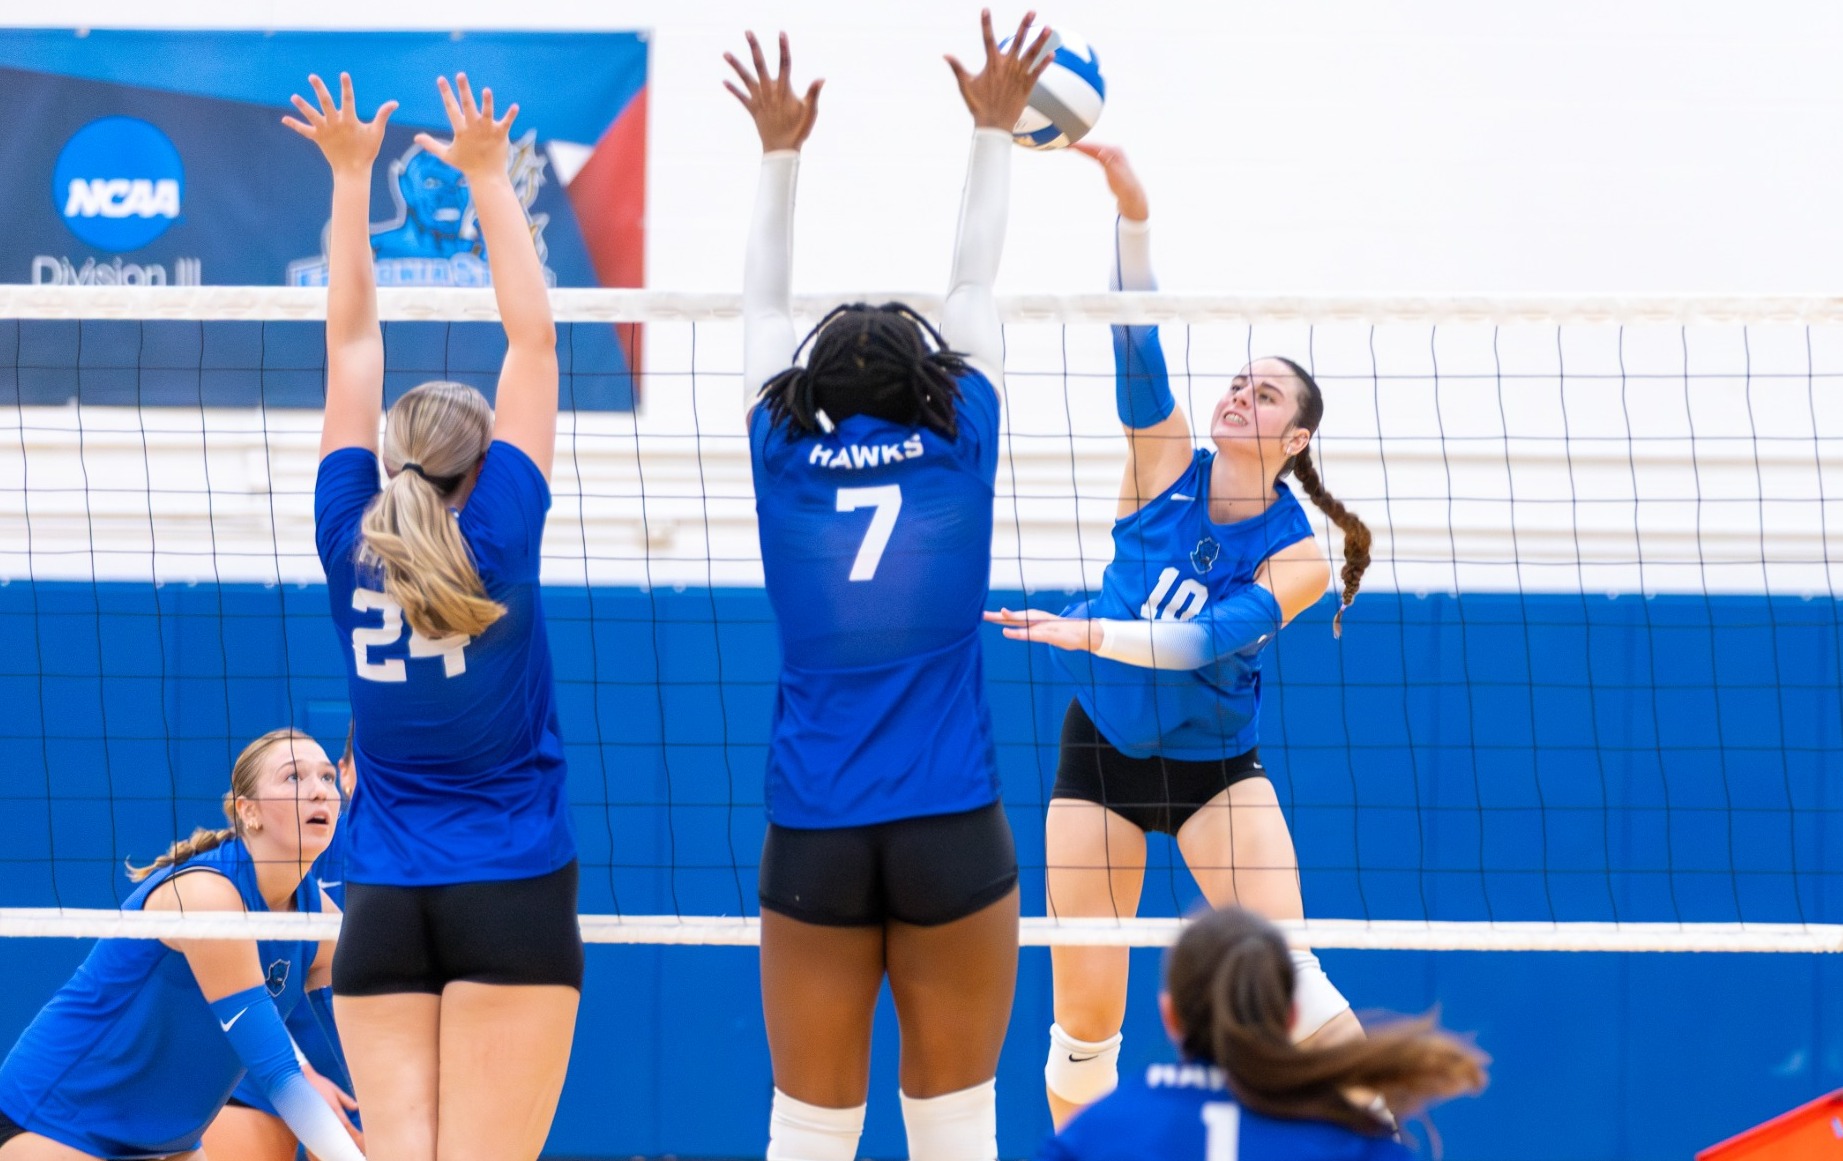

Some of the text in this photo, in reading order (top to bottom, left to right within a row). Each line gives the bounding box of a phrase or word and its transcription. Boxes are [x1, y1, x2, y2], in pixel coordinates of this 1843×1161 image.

[64, 178, 180, 219] NCAA
[32, 255, 167, 286] Division
[809, 433, 924, 470] HAWKS
[836, 483, 903, 582] 7
[1140, 566, 1209, 622] 10
[352, 587, 471, 683] 24
[1202, 1102, 1240, 1161] 1
